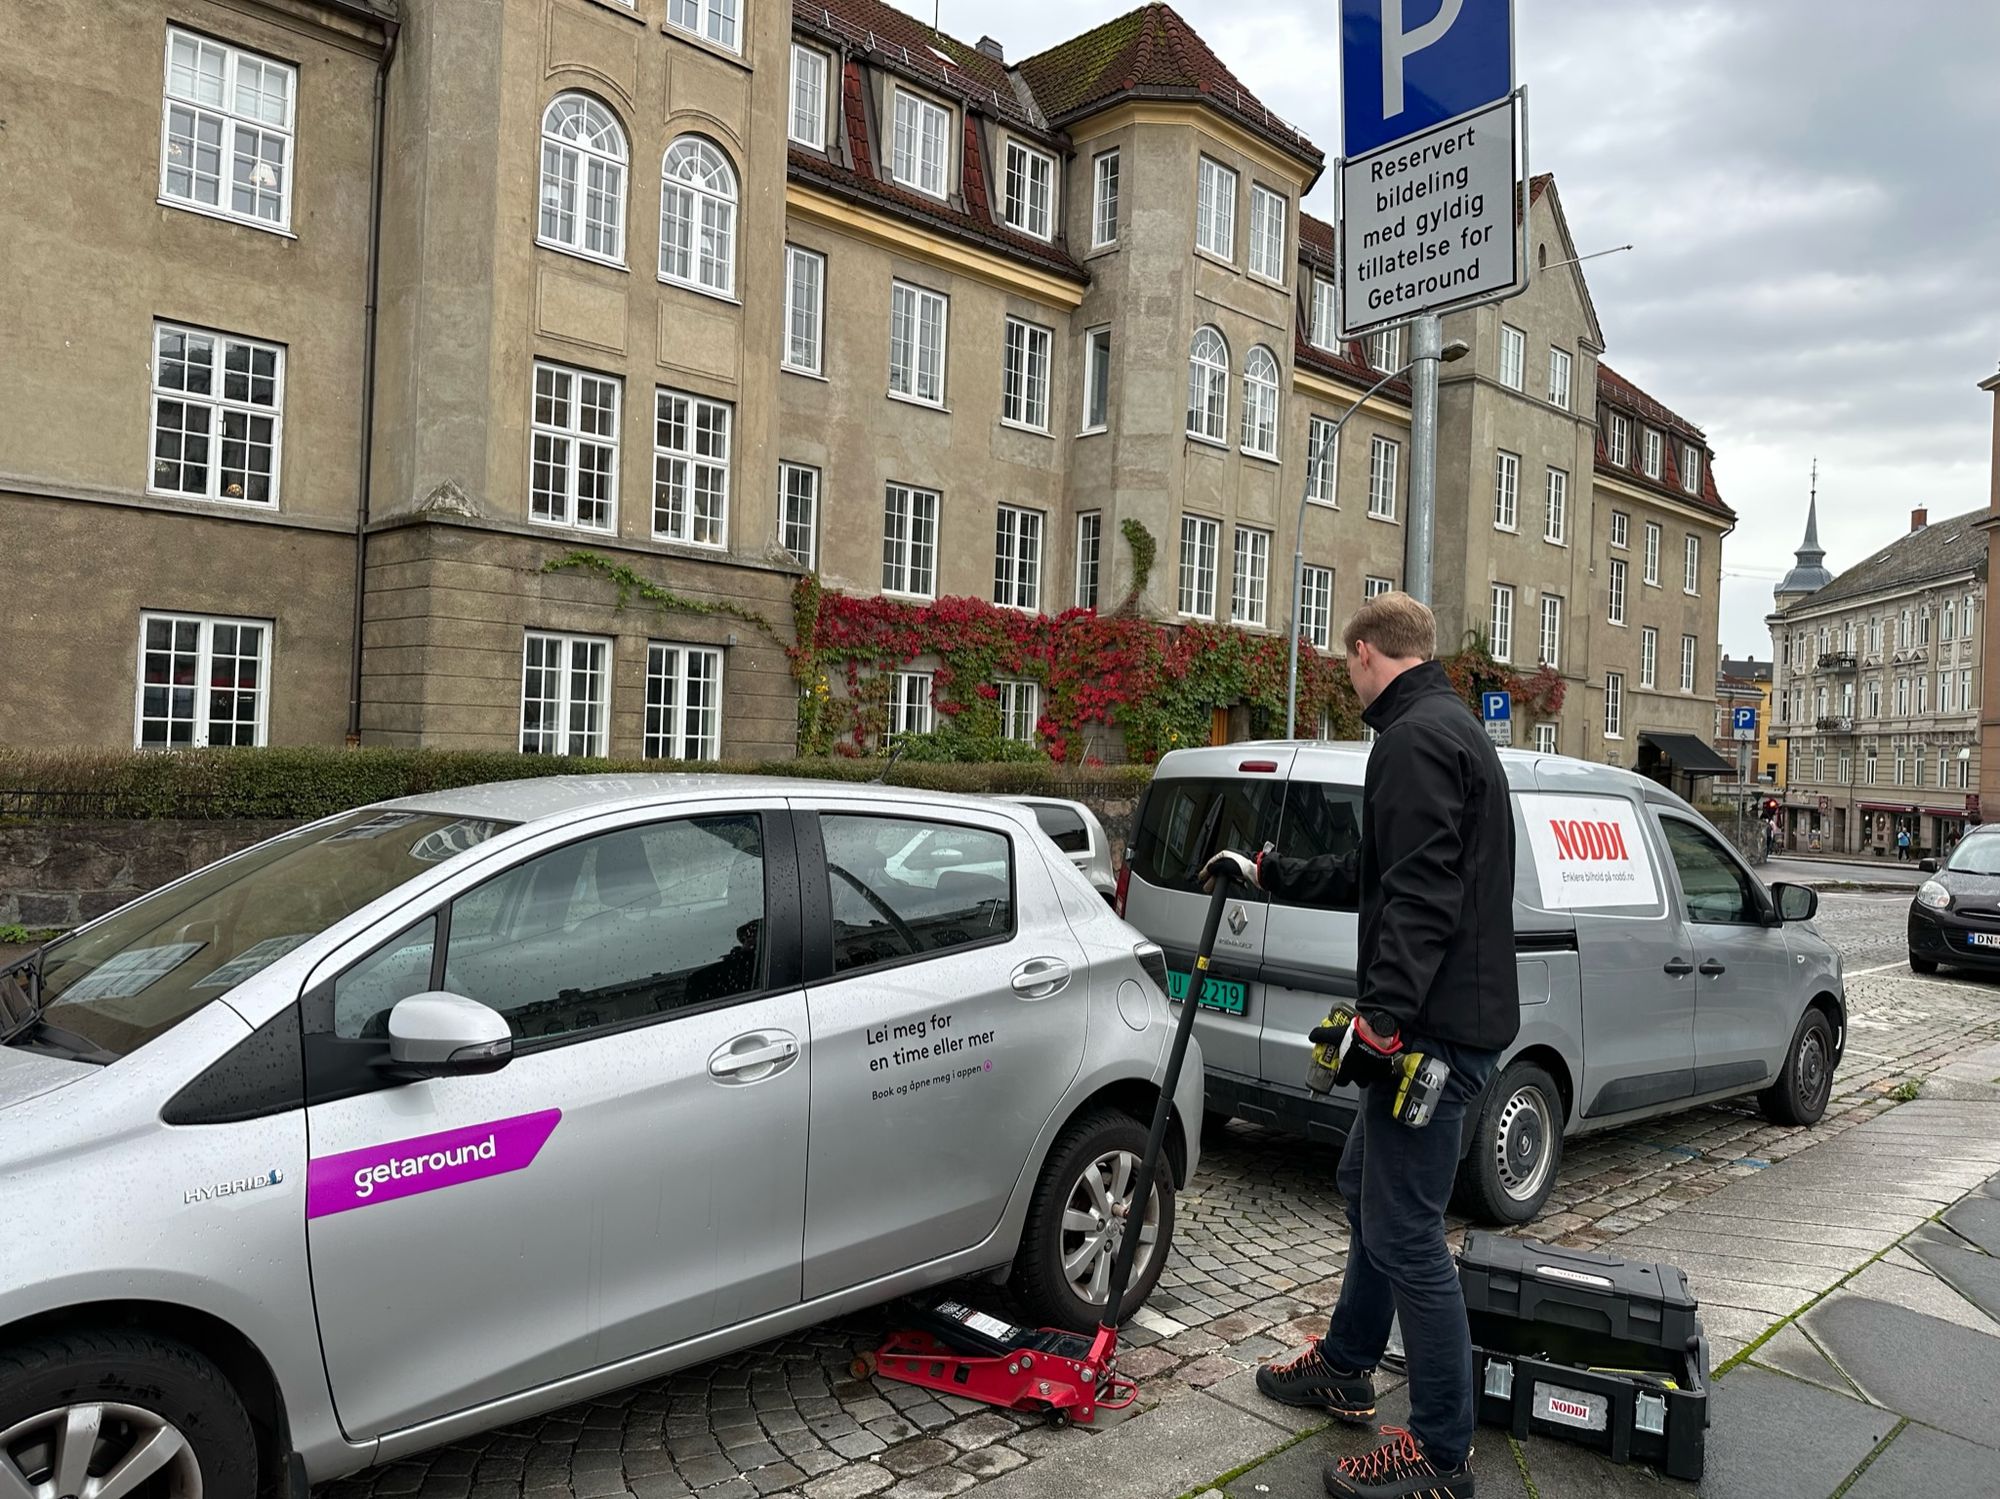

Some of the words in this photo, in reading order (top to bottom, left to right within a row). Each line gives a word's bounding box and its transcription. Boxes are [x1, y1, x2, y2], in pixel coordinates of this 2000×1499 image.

[1381, 0, 1463, 120] P
[1371, 126, 1475, 183] Reservert
[1376, 165, 1469, 213] bildeling
[1363, 217, 1412, 249] med
[1416, 194, 1484, 237] gyldig
[1358, 239, 1450, 282] tillatelse
[1461, 223, 1493, 250] for
[1368, 258, 1480, 310] Getaround
[1489, 696, 1504, 717] P
[1739, 710, 1750, 726] P
[1549, 820, 1629, 861] NODDI
[1562, 871, 1584, 883] Enklere
[1585, 871, 1604, 882] bilhold
[1605, 871, 1612, 883] på
[1612, 871, 1635, 882] noddi.no
[1977, 934, 1994, 945] DN
[1199, 980, 1239, 1006] 2219
[867, 1025, 888, 1045] Lei
[893, 1021, 927, 1038] meg
[930, 1014, 952, 1031] for
[869, 1057, 889, 1071] en
[893, 1047, 930, 1066] time
[933, 1037, 964, 1055] eller
[968, 1029, 995, 1047] mer
[872, 1087, 895, 1100] Book
[896, 1084, 908, 1095] og
[909, 1079, 931, 1092] åpne
[932, 1073, 950, 1084] meg
[952, 1070, 955, 1079] i
[957, 1065, 982, 1080] appen
[354, 1135, 496, 1198] getaround
[184, 1174, 267, 1204] HYBRID
[1551, 1399, 1588, 1419] NODDI
